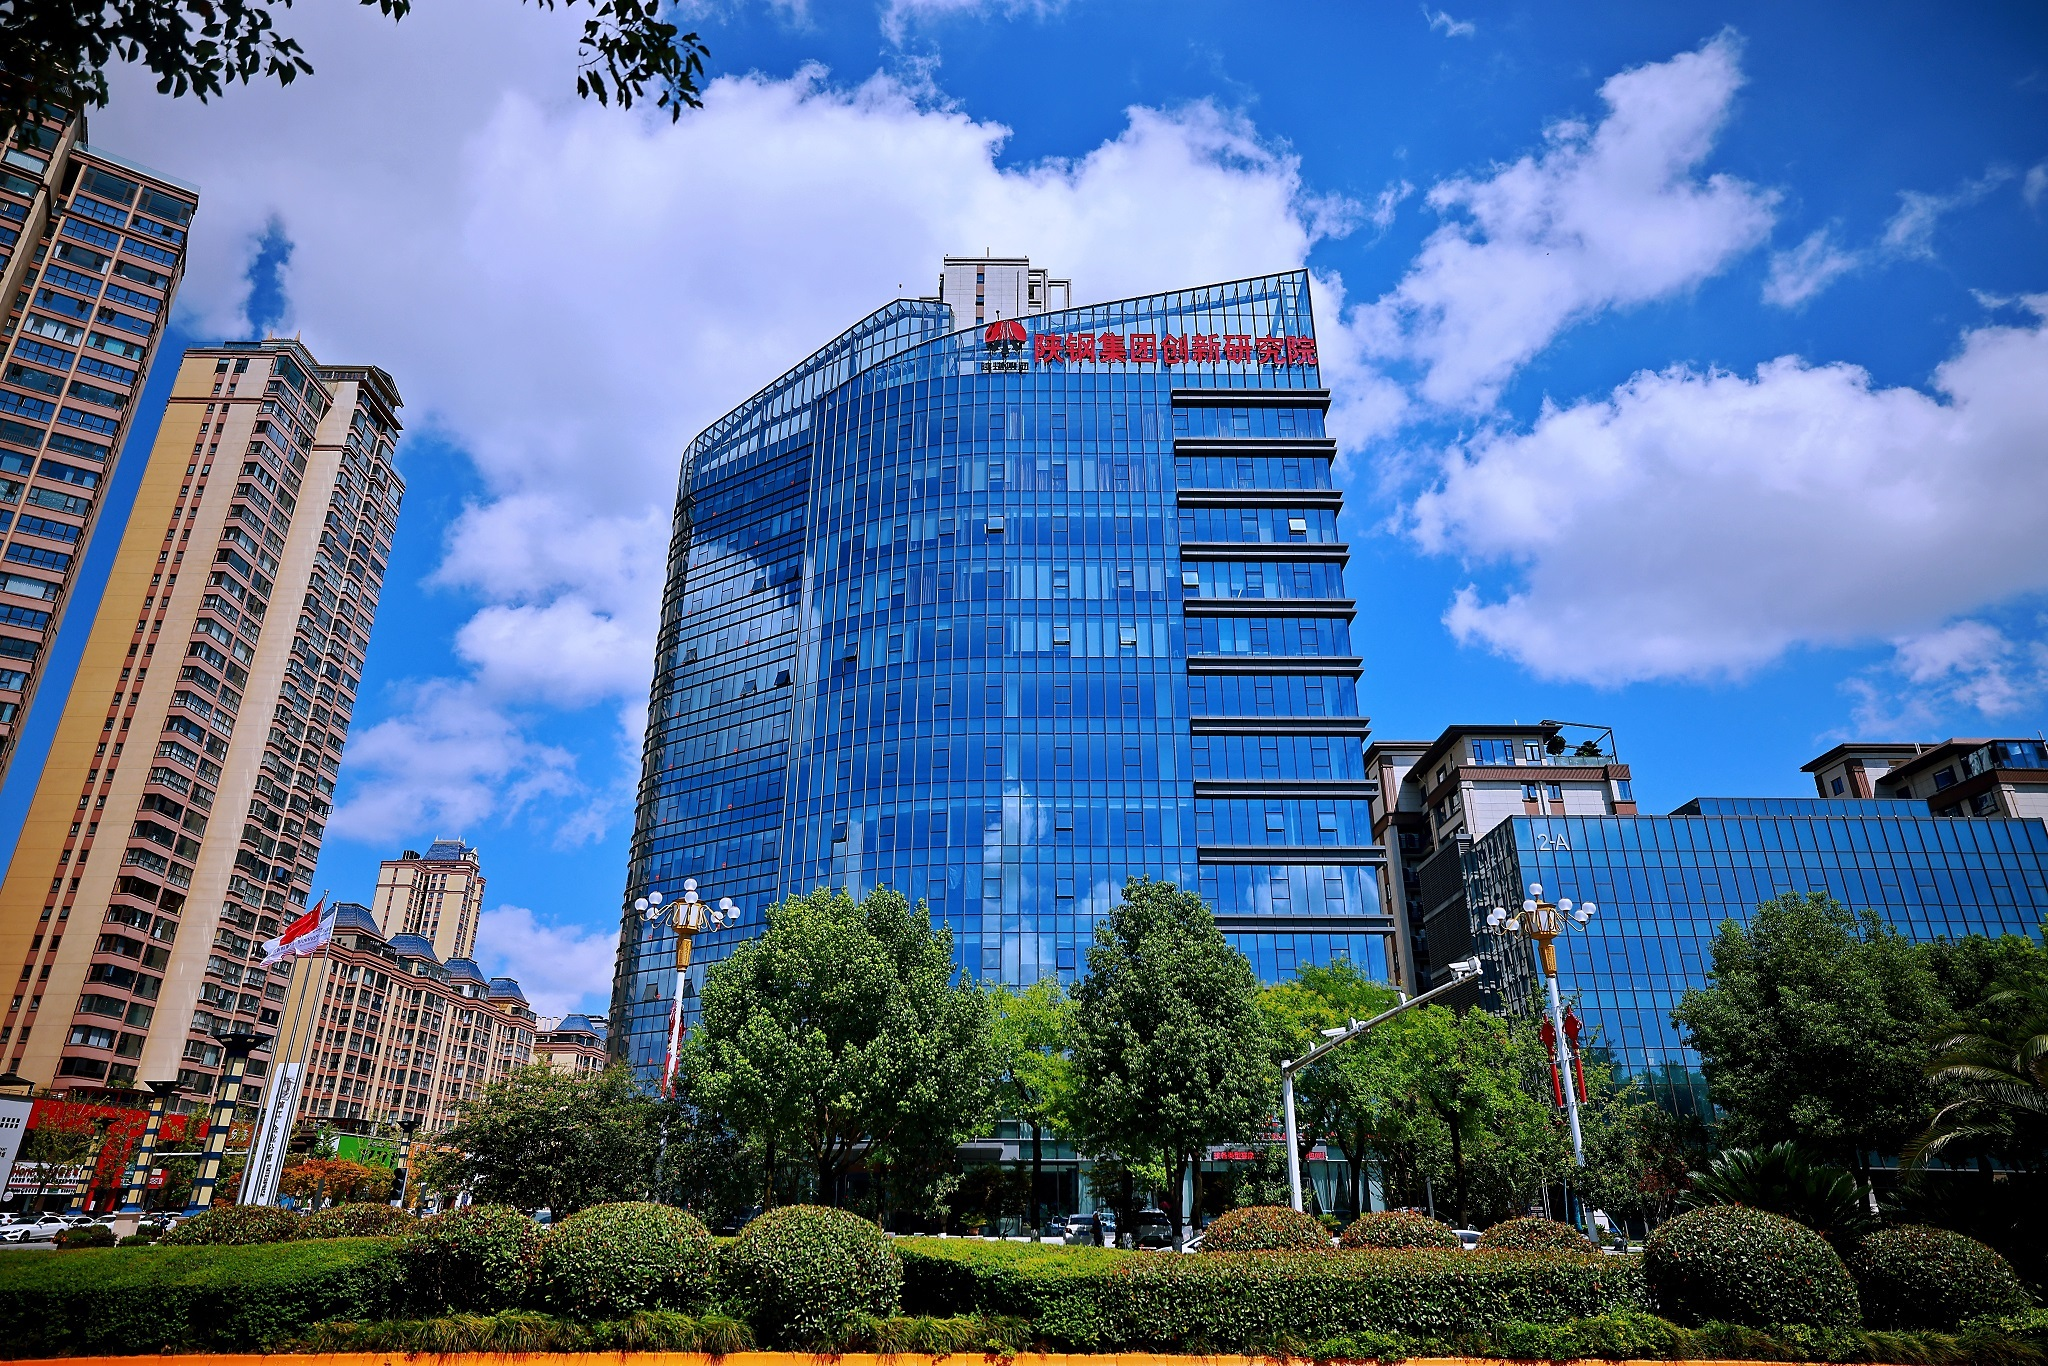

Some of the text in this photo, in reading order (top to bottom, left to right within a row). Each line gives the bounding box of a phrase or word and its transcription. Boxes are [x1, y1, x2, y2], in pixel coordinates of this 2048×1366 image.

[1034, 332, 1317, 364] 陕钢集团创新研究院
[1537, 833, 1570, 851] 2-A
